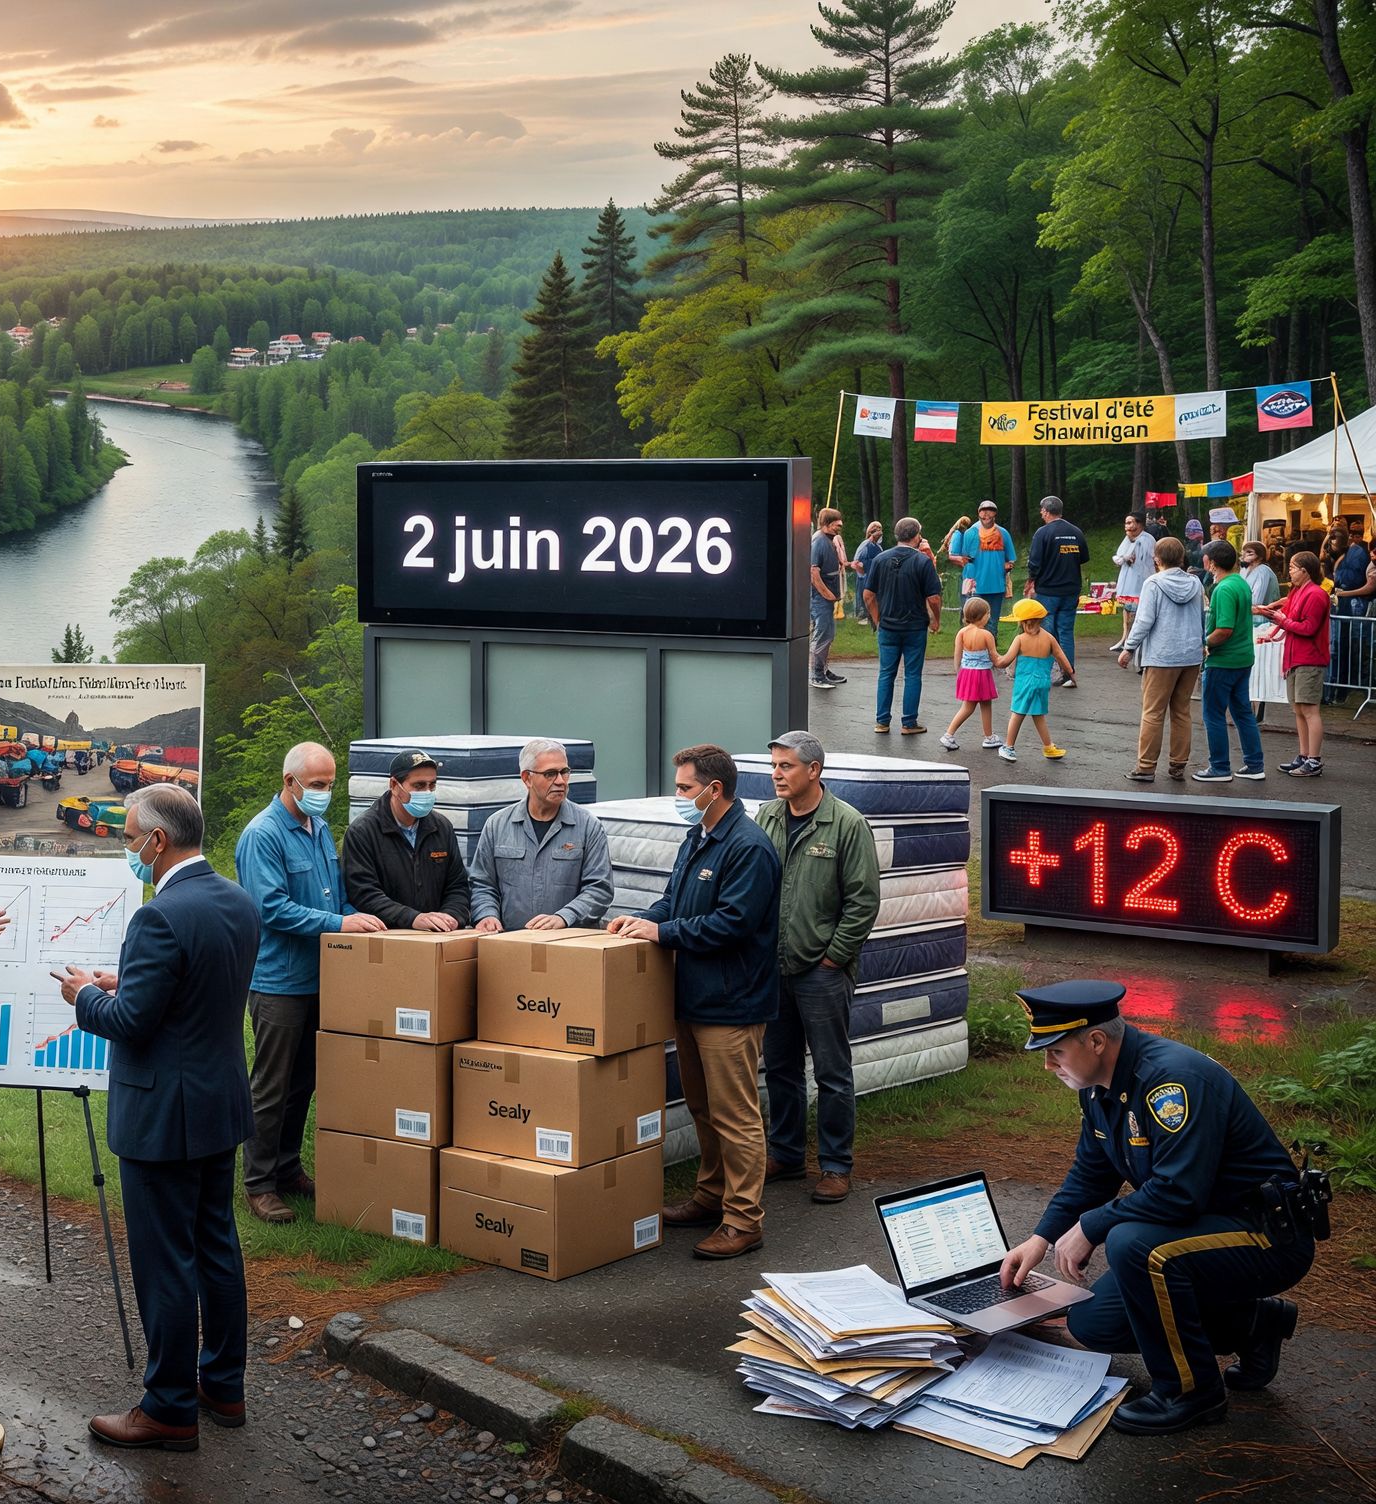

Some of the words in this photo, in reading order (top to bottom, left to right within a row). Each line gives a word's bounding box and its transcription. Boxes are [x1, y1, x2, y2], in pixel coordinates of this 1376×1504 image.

[1027, 402, 1099, 421] Festival
[1105, 399, 1155, 420] d'été
[1033, 422, 1149, 443] Shawinigan
[402, 514, 435, 568] 2
[447, 515, 561, 584] juin
[580, 516, 733, 575] 2026
[1217, 831, 1289, 922] C
[516, 994, 562, 1019] Sealy
[488, 1100, 531, 1124] Sealy
[475, 1212, 515, 1238] Sealy
